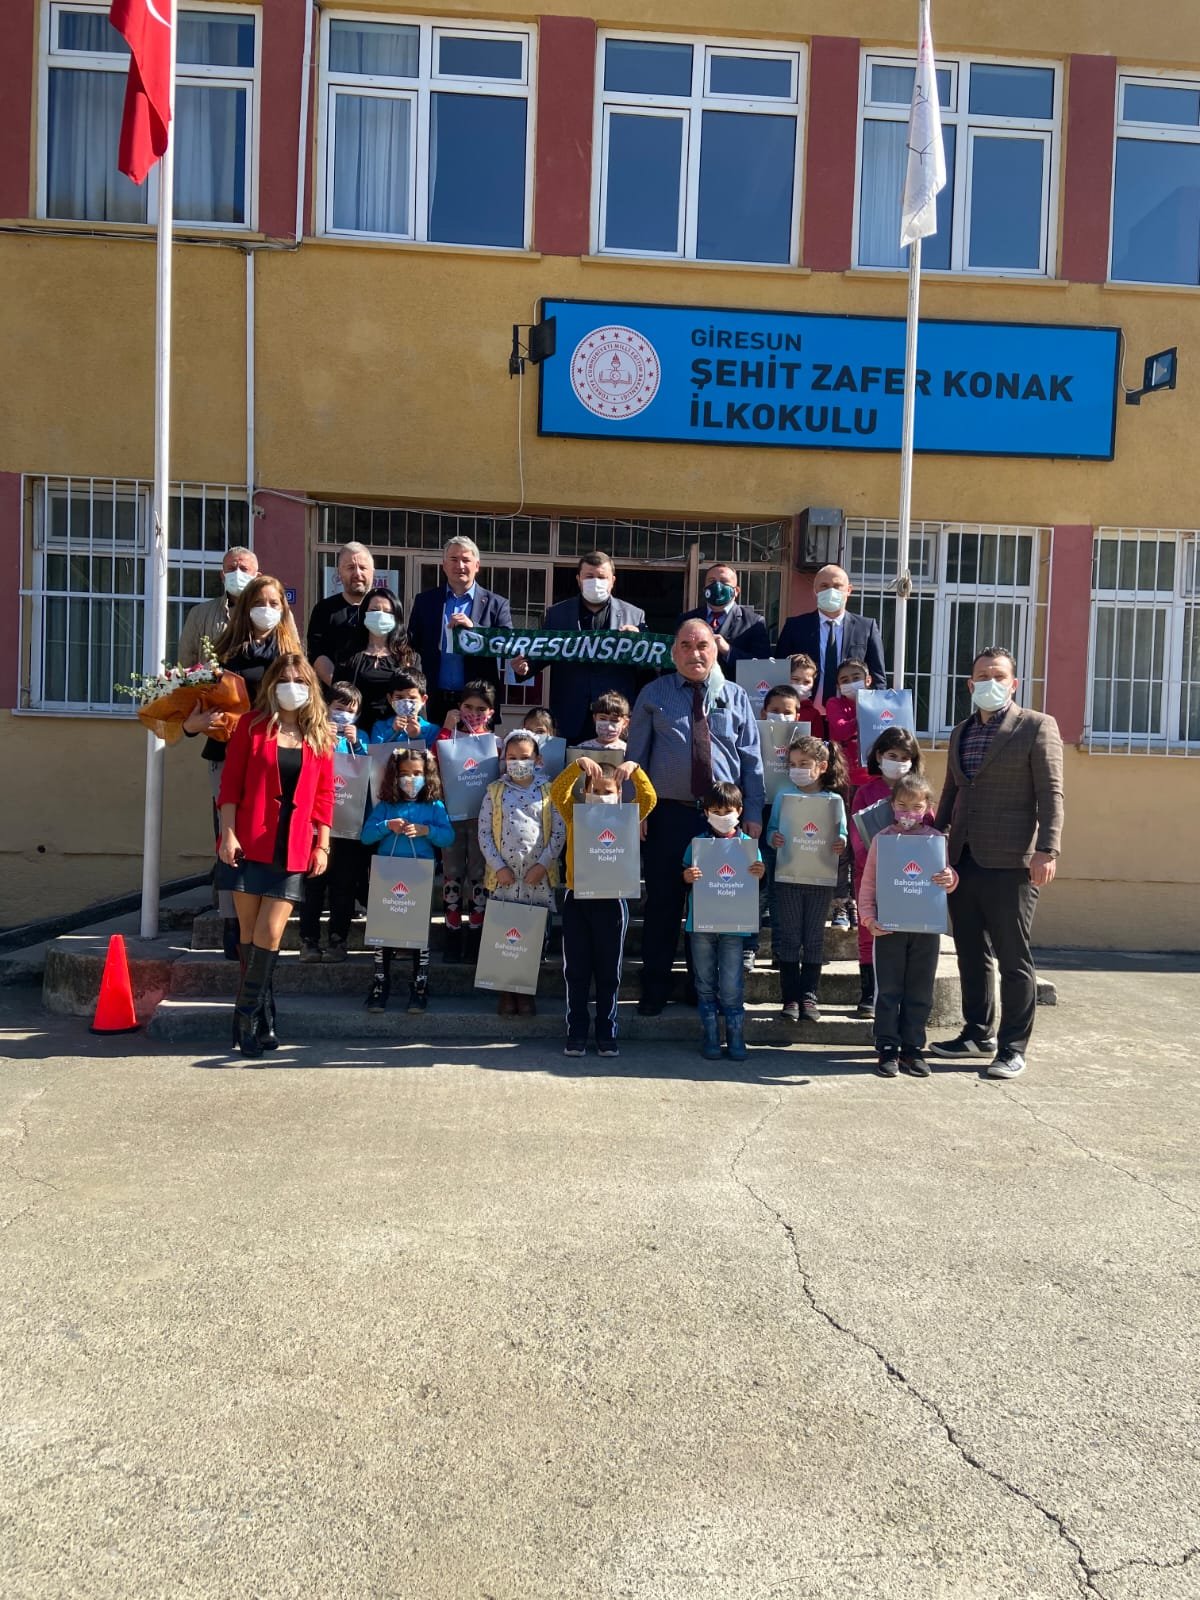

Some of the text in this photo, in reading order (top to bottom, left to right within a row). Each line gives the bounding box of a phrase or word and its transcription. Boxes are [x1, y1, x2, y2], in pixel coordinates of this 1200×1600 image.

[691, 325, 801, 351] GİRESUN
[690, 354, 1074, 402] ŞEHİT ZAFER KONAK
[690, 393, 877, 434] İLKOKULU
